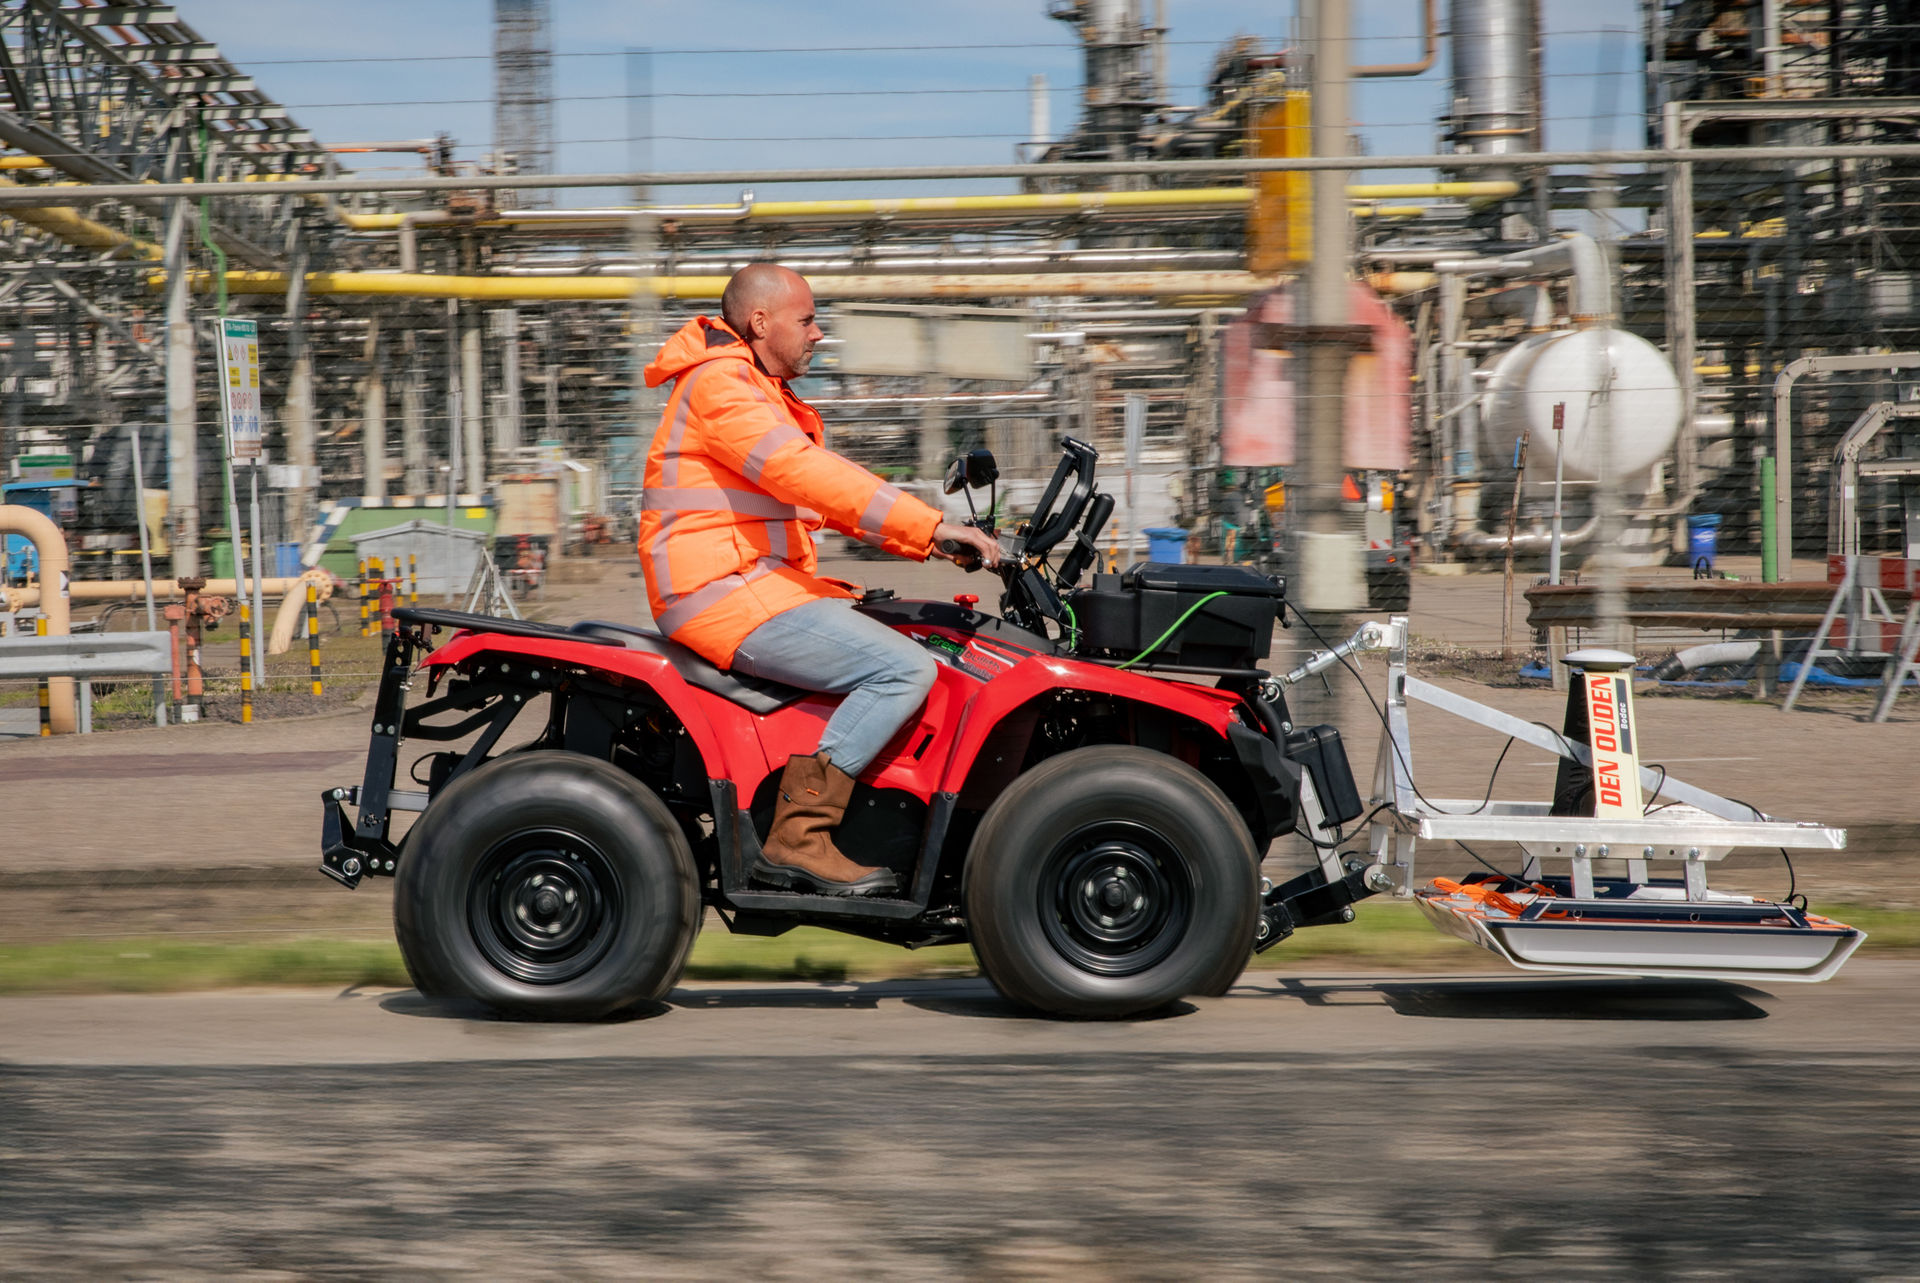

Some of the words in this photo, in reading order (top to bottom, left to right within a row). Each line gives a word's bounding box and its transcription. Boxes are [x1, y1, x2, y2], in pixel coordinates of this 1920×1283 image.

[928, 634, 964, 655] Green
[1590, 674, 1616, 752] OUDEN
[1620, 702, 1628, 729] Bodac
[1597, 759, 1622, 807] DEN
